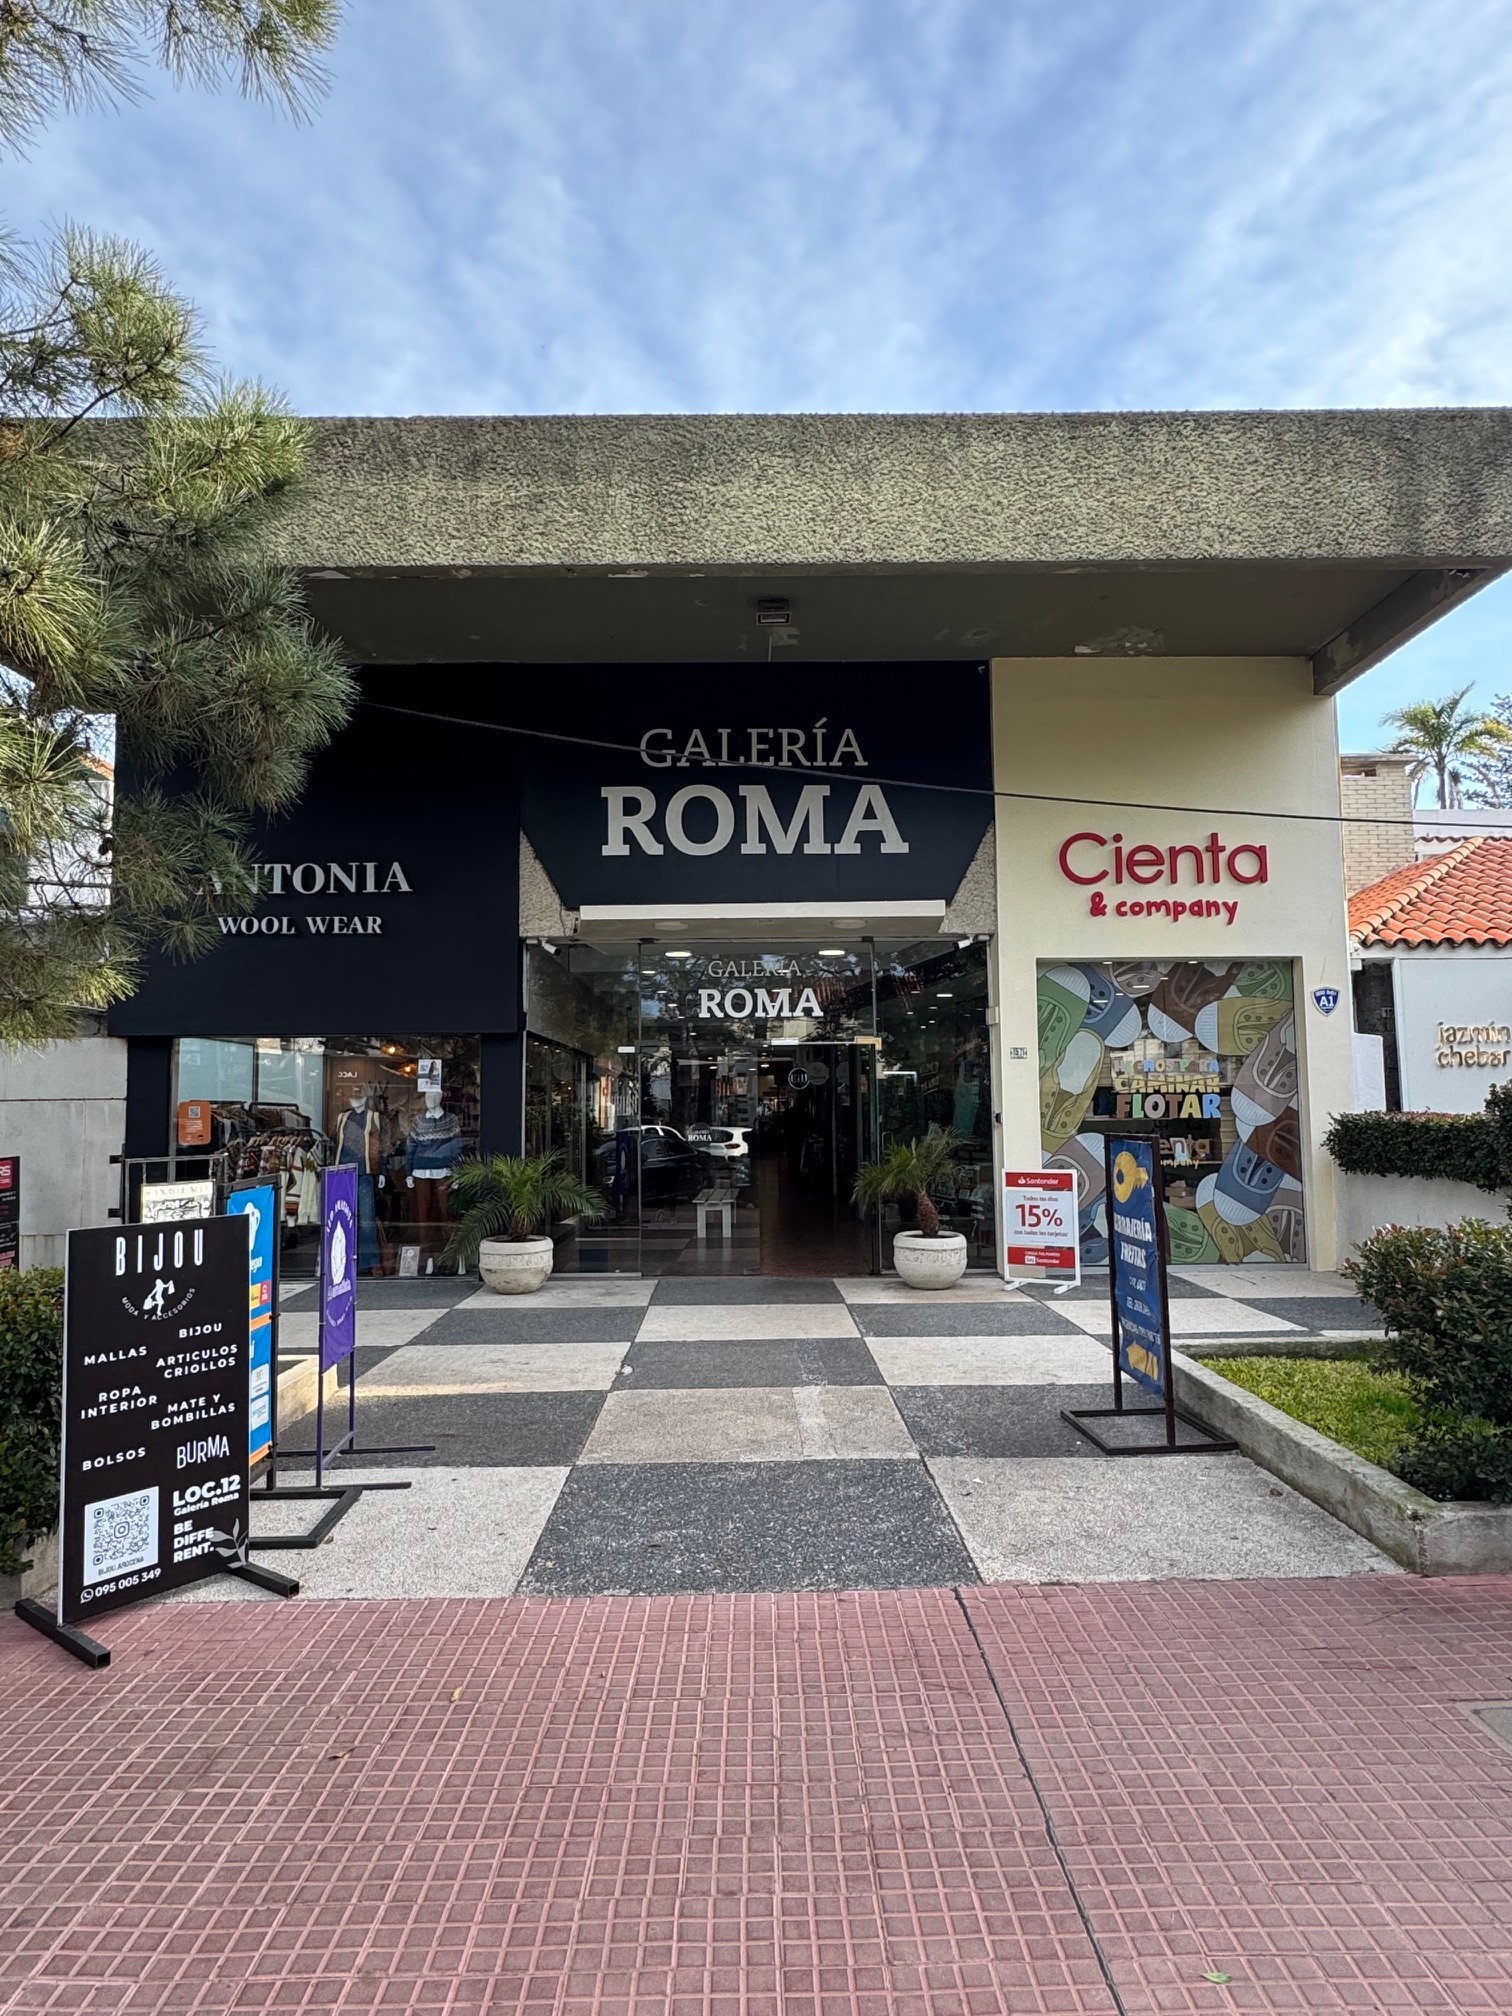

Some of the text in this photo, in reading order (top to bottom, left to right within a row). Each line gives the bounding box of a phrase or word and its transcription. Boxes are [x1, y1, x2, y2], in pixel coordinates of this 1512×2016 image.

[640, 717, 868, 767] GALERÍA
[601, 784, 909, 856] ROMA
[1059, 832, 1268, 885] Cienta
[1089, 891, 1239, 926] & company
[217, 916, 383, 934] WOOL WEAR
[698, 987, 824, 1018] ROMA
[1319, 995, 1335, 1007] A1
[1437, 1045, 1511, 1067] chebar
[1115, 1093, 1221, 1119] FLOTAR
[1026, 1177, 1060, 1185] Santander
[1015, 1203, 1063, 1228] 15%
[115, 1229, 204, 1276] BIJOU
[121, 1296, 139, 1317] MODA
[178, 1323, 222, 1339] BIJOU
[84, 1346, 147, 1366] MALLAS
[156, 1344, 238, 1368] ARTICULOS
[164, 1357, 236, 1379] CRIOLLOS
[98, 1386, 142, 1403] ROPA
[167, 1393, 221, 1414] MATE Y
[80, 1395, 158, 1419] INTERIOR
[150, 1403, 236, 1430] BOMBILLAS
[82, 1447, 147, 1471] BOLSOS
[176, 1434, 230, 1469] BURMA
[173, 1474, 241, 1508] LOC.12
[211, 1491, 240, 1507] Roma
[173, 1519, 194, 1536] BE
[173, 1527, 215, 1550] DIFFE
[173, 1542, 215, 1564] RENT.
[95, 1567, 161, 1597] 095 005 349
